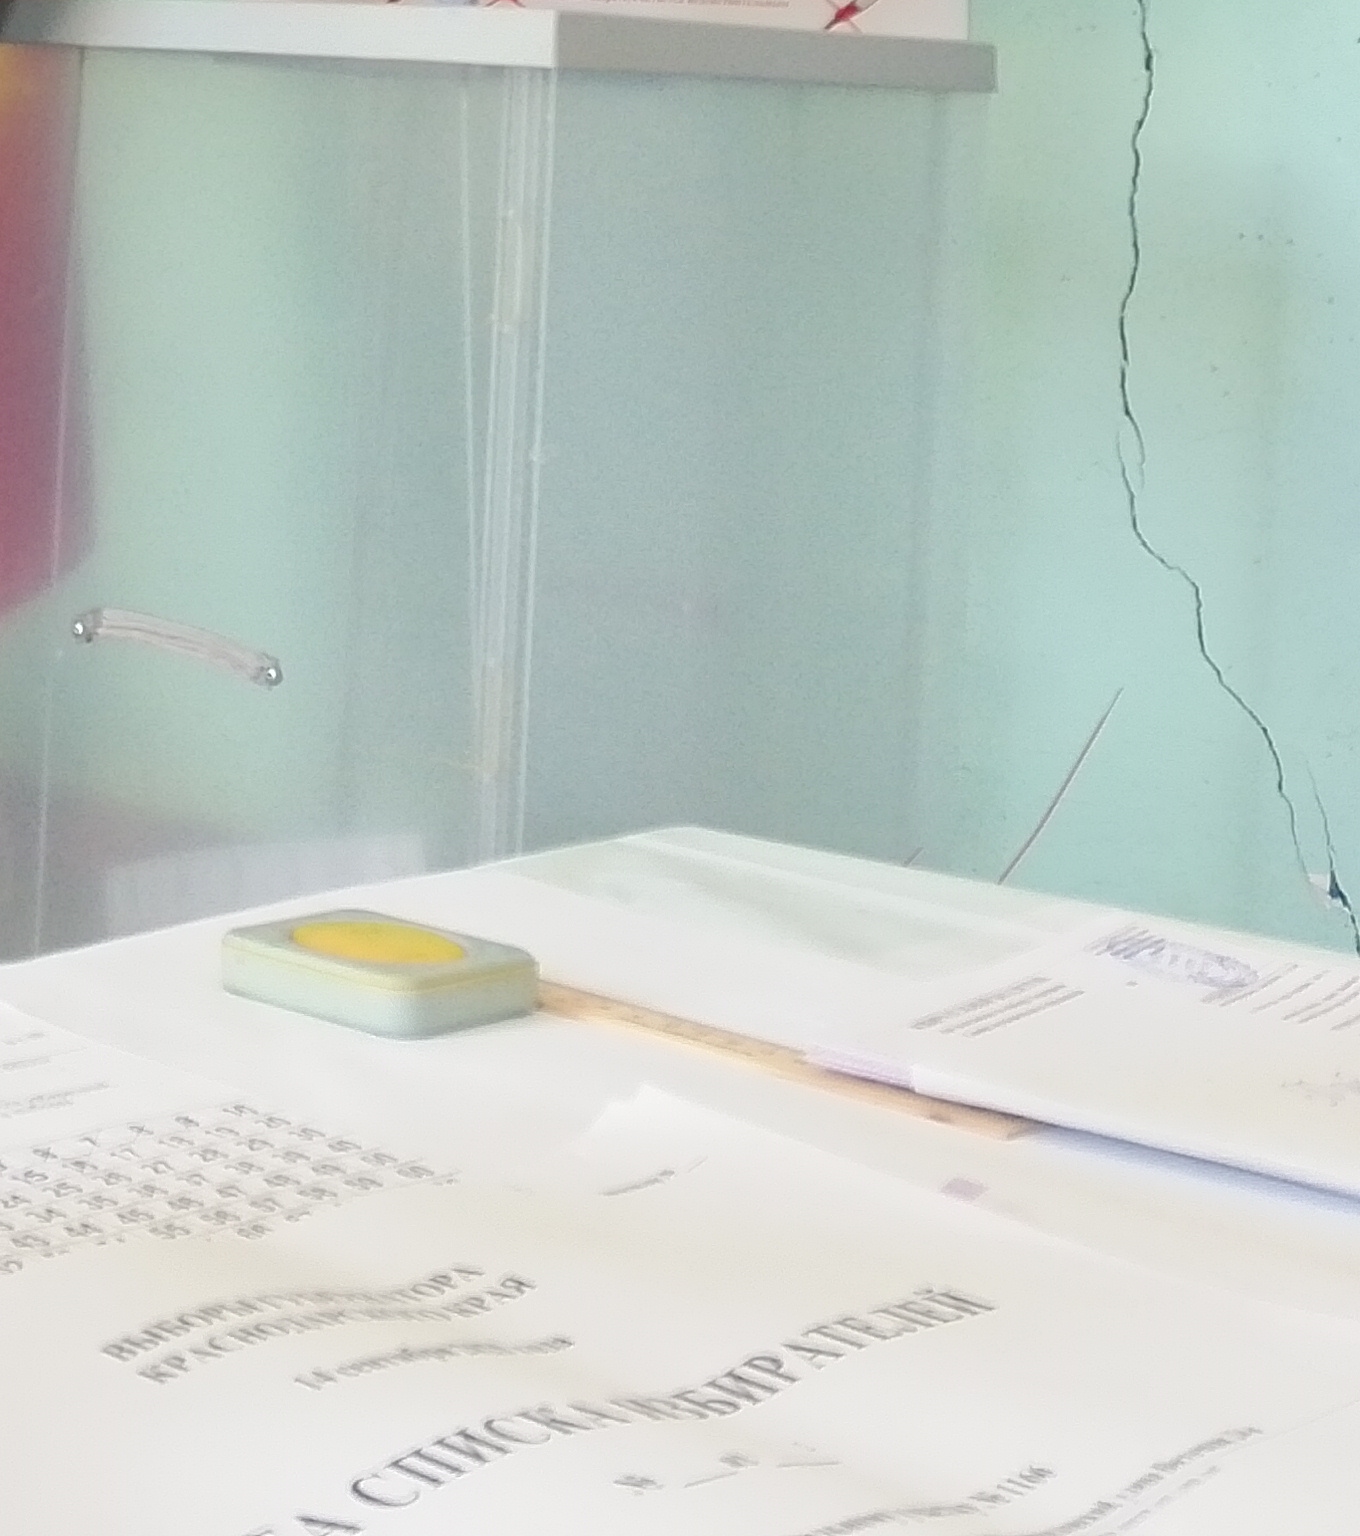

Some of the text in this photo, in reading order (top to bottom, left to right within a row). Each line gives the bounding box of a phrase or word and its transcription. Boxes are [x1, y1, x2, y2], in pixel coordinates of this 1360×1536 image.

[440, 1272, 538, 1324] КРАЯ
[101, 1295, 253, 1364] ВЫБОРЫ
[292, 1366, 339, 1392] 14
[350, 1286, 997, 1509] СПИСКА ИЗБИРАТЕЛЕЙ
